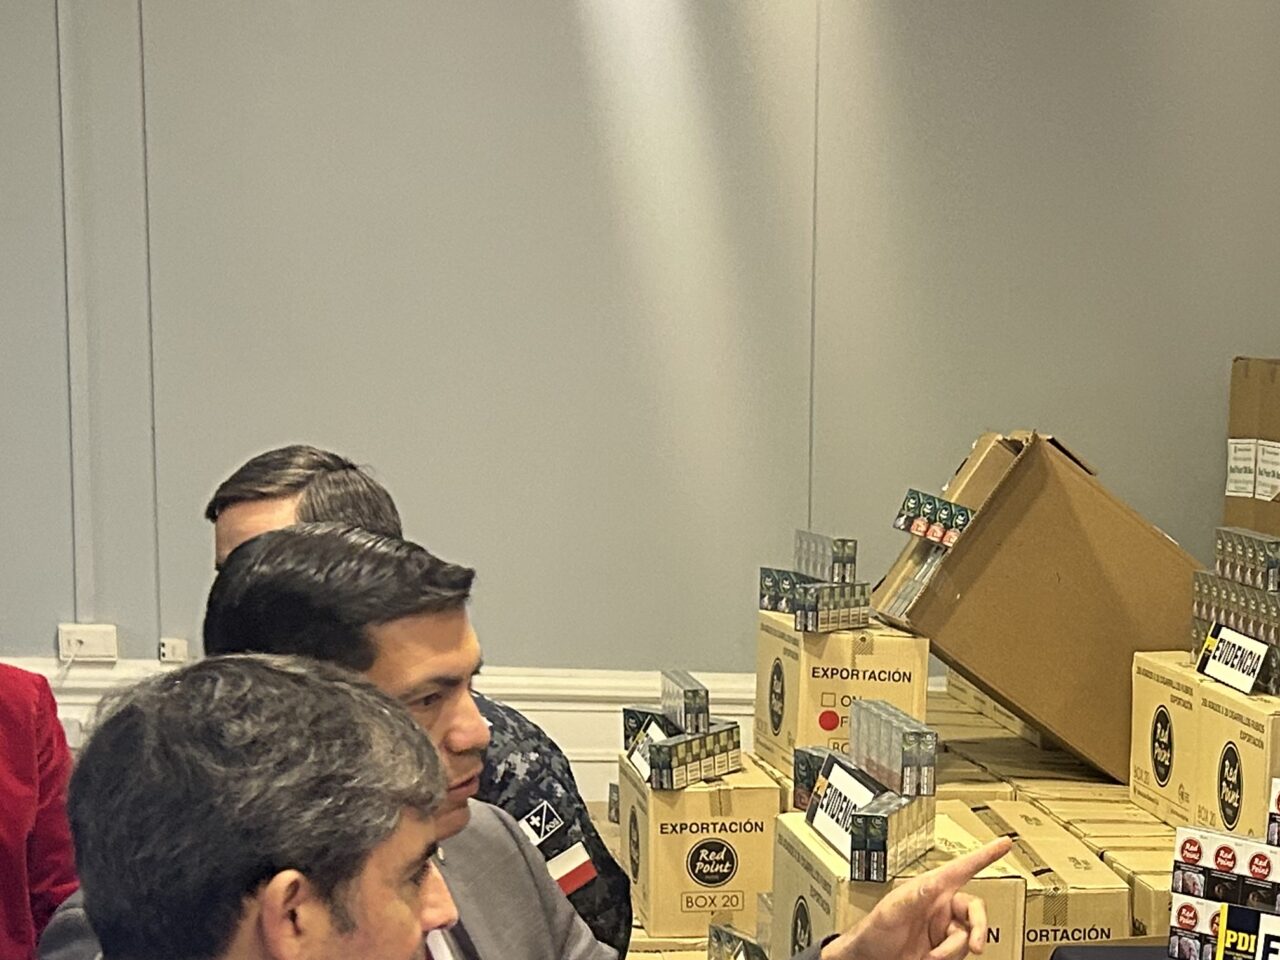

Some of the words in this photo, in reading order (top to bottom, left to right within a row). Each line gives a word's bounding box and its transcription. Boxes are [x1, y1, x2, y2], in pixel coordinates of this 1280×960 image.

[1212, 638, 1262, 679] EVIDENCIA
[812, 666, 912, 683] EXPORTACIÓN
[660, 819, 764, 834] EXPORTACIÓN
[699, 849, 725, 861] Red
[695, 861, 732, 874] Point
[686, 896, 717, 908] BOX
[723, 895, 739, 907] 20
[1224, 929, 1257, 952] PDI
